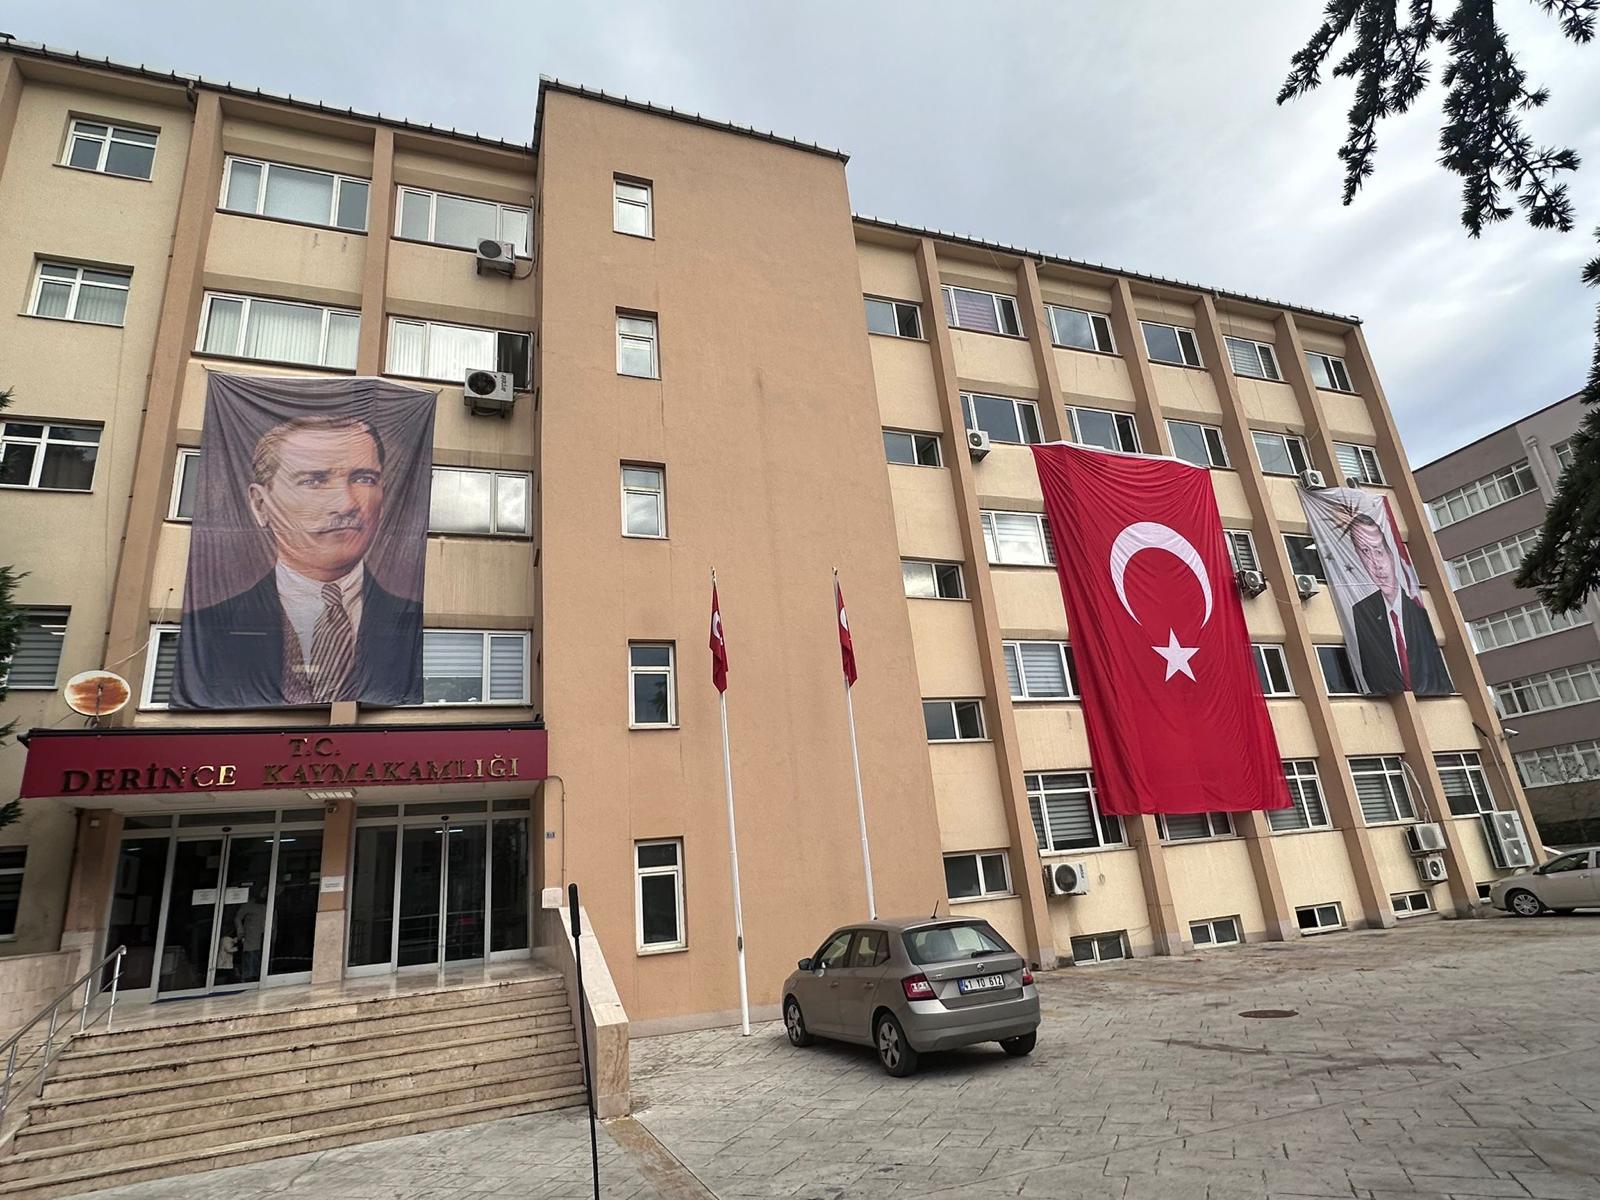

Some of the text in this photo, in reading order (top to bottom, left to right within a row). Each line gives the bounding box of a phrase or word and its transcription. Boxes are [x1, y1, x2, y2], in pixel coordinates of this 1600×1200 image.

[289, 737, 341, 757] T.C.
[60, 754, 520, 793] DERİNCE KAYMAKAMLIĞI
